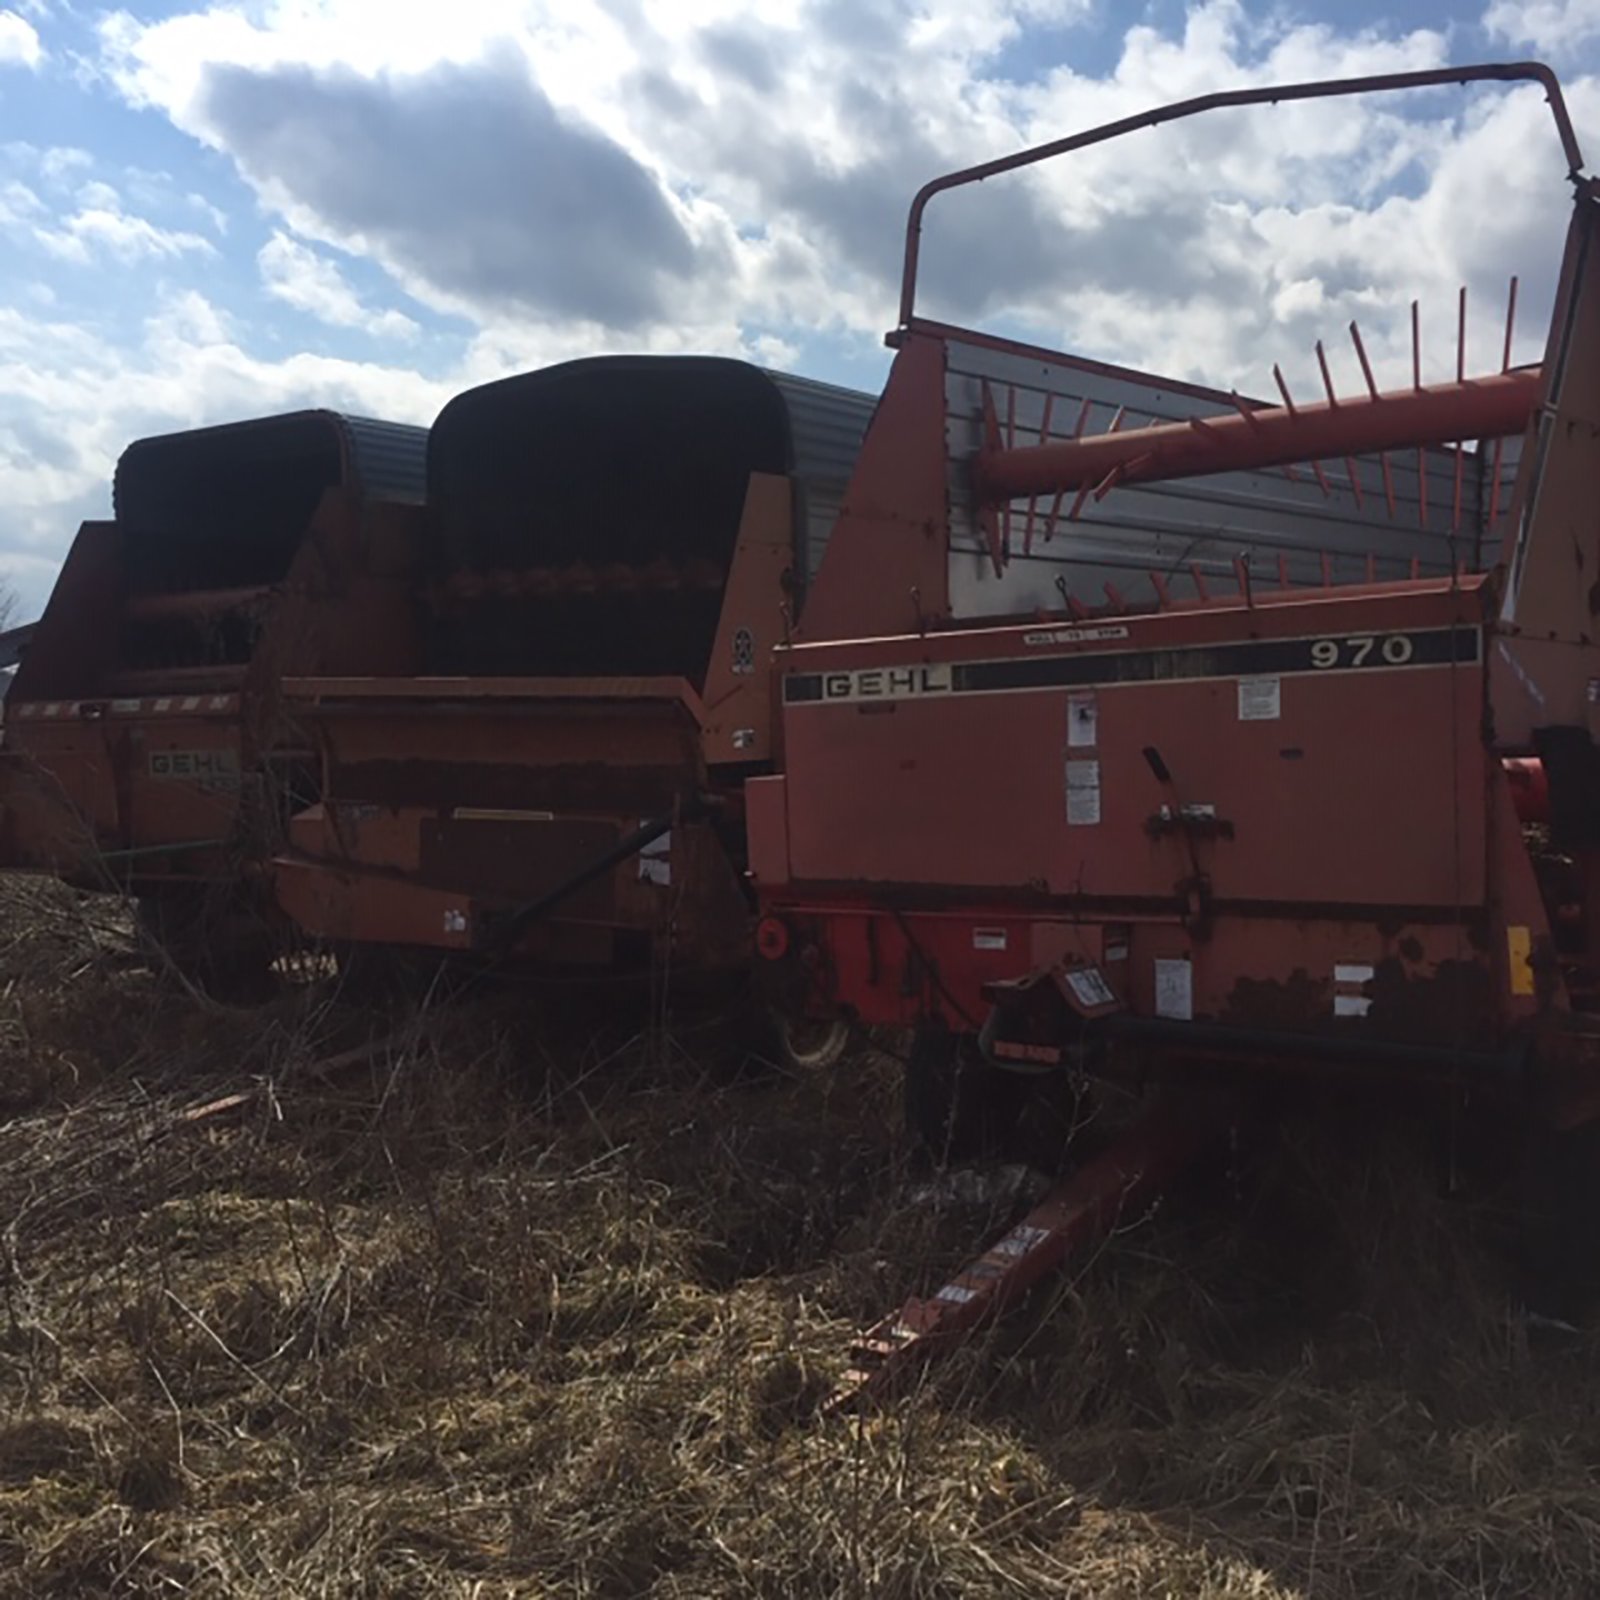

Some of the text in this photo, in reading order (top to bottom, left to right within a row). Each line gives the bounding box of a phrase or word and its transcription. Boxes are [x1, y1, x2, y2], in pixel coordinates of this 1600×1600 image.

[1310, 635, 1413, 669] 970
[826, 668, 948, 697] GEHL
[152, 753, 232, 774] GEHL
